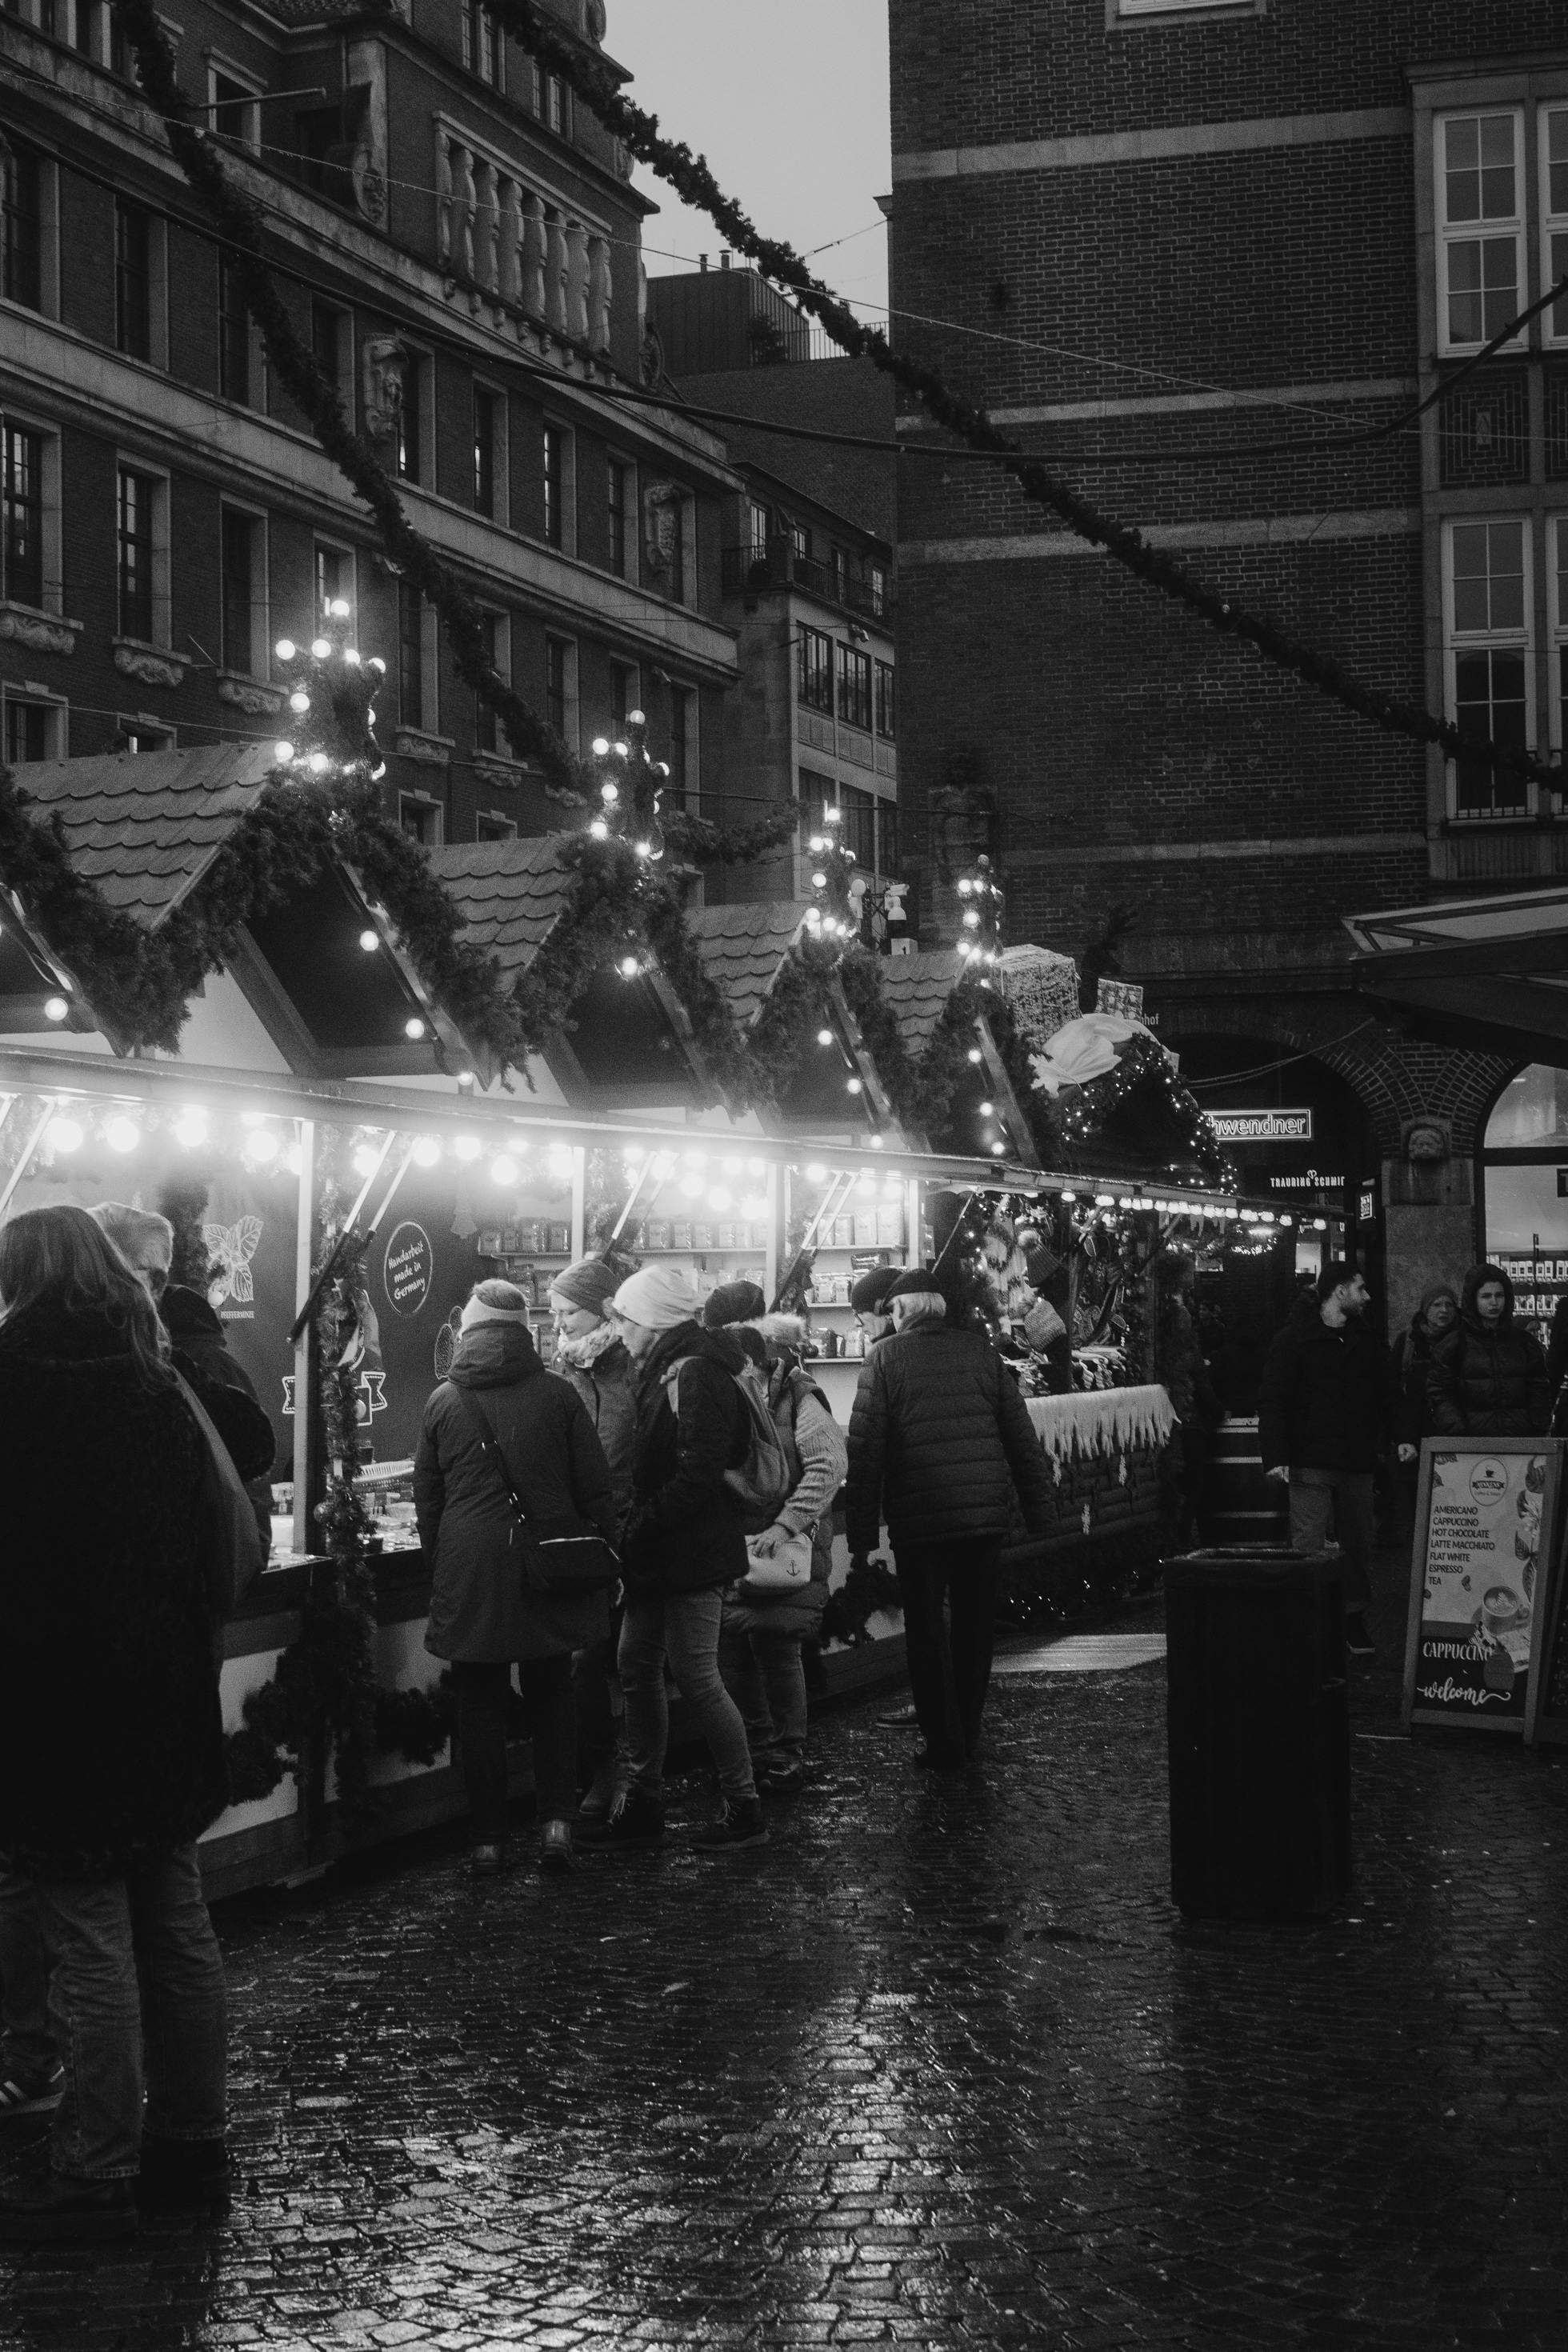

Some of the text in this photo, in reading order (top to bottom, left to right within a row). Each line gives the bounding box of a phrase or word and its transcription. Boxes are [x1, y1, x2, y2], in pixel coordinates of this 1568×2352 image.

[1270, 1177, 1310, 1188] TRAURING
[394, 1262, 422, 1283] made in
[394, 1278, 425, 1300] Germany
[1434, 1506, 1478, 1514] AMERICANO
[1433, 1517, 1478, 1526] CAPPUCCINO
[1432, 1528, 1490, 1538] HOT CHOCOLATE
[1430, 1540, 1495, 1550] LATTE MACCHIATO
[1430, 1552, 1470, 1562] FLAT WHITE
[1429, 1564, 1463, 1574] ESPRESSO
[1428, 1576, 1442, 1585] TEA
[1417, 1677, 1510, 1706] welcome
